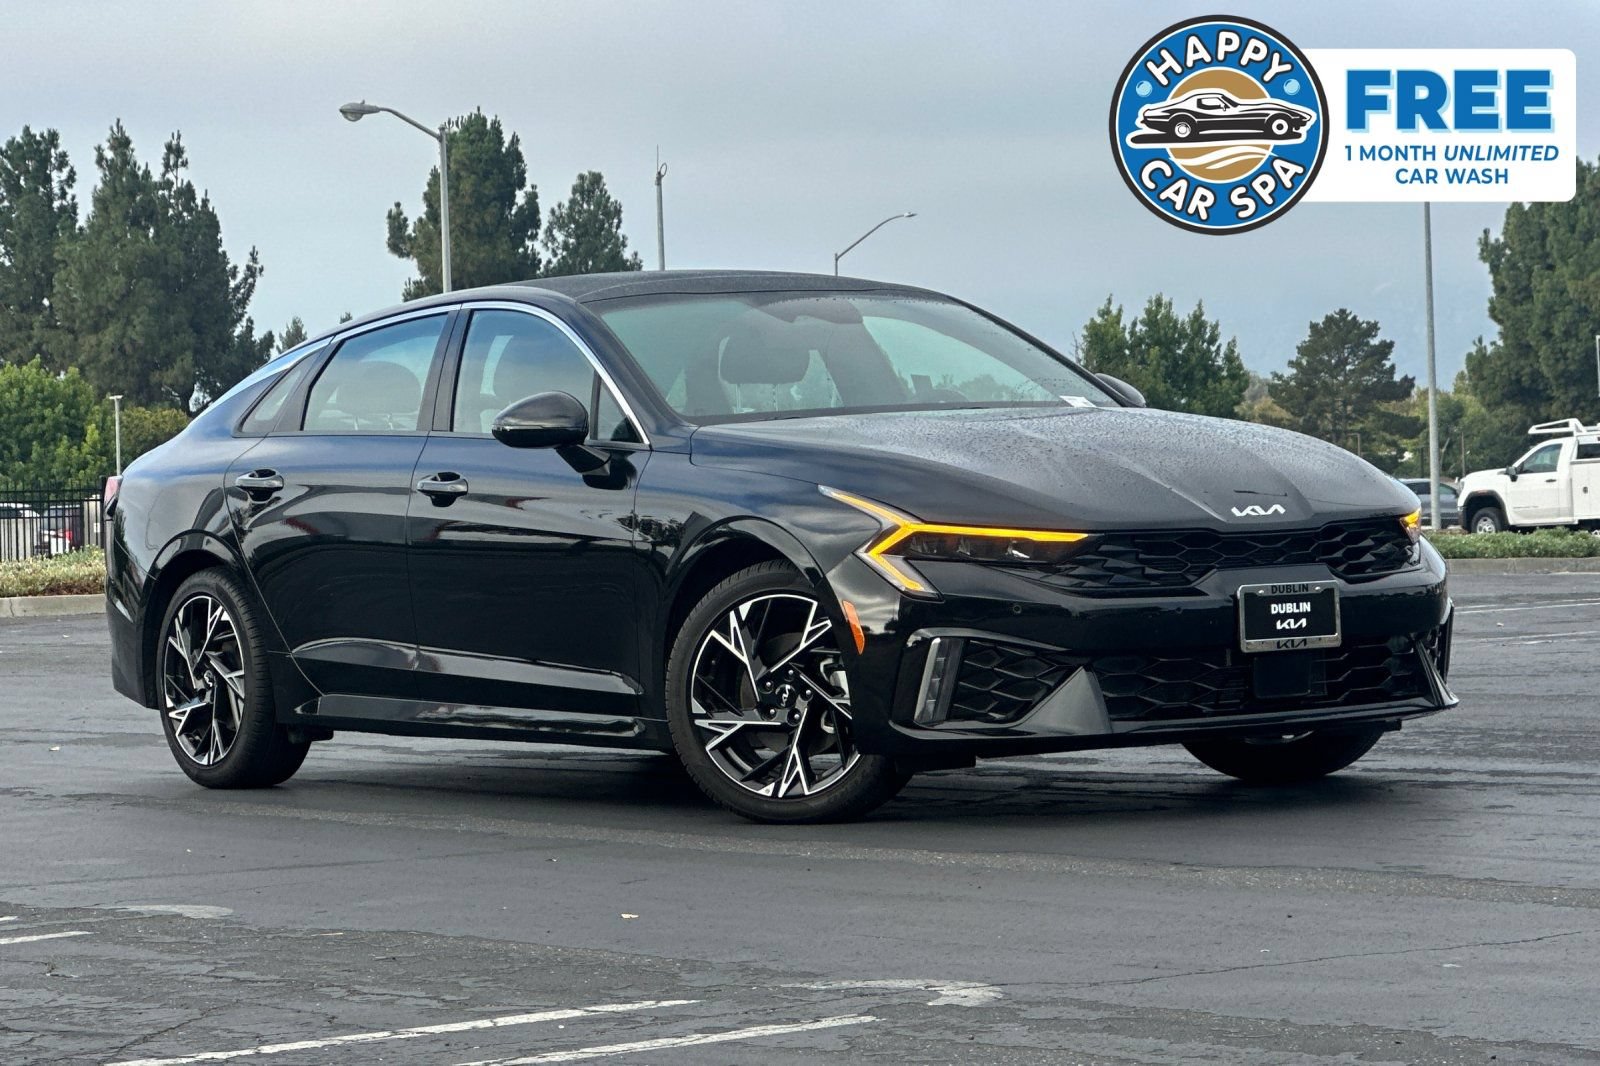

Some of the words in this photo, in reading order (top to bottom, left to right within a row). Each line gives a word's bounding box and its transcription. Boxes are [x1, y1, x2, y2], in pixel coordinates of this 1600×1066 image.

[1271, 584, 1309, 594] DUBLIN
[1271, 602, 1311, 614] DUBLIN
[1276, 618, 1307, 630] KIA
[1277, 638, 1307, 649] KIA
